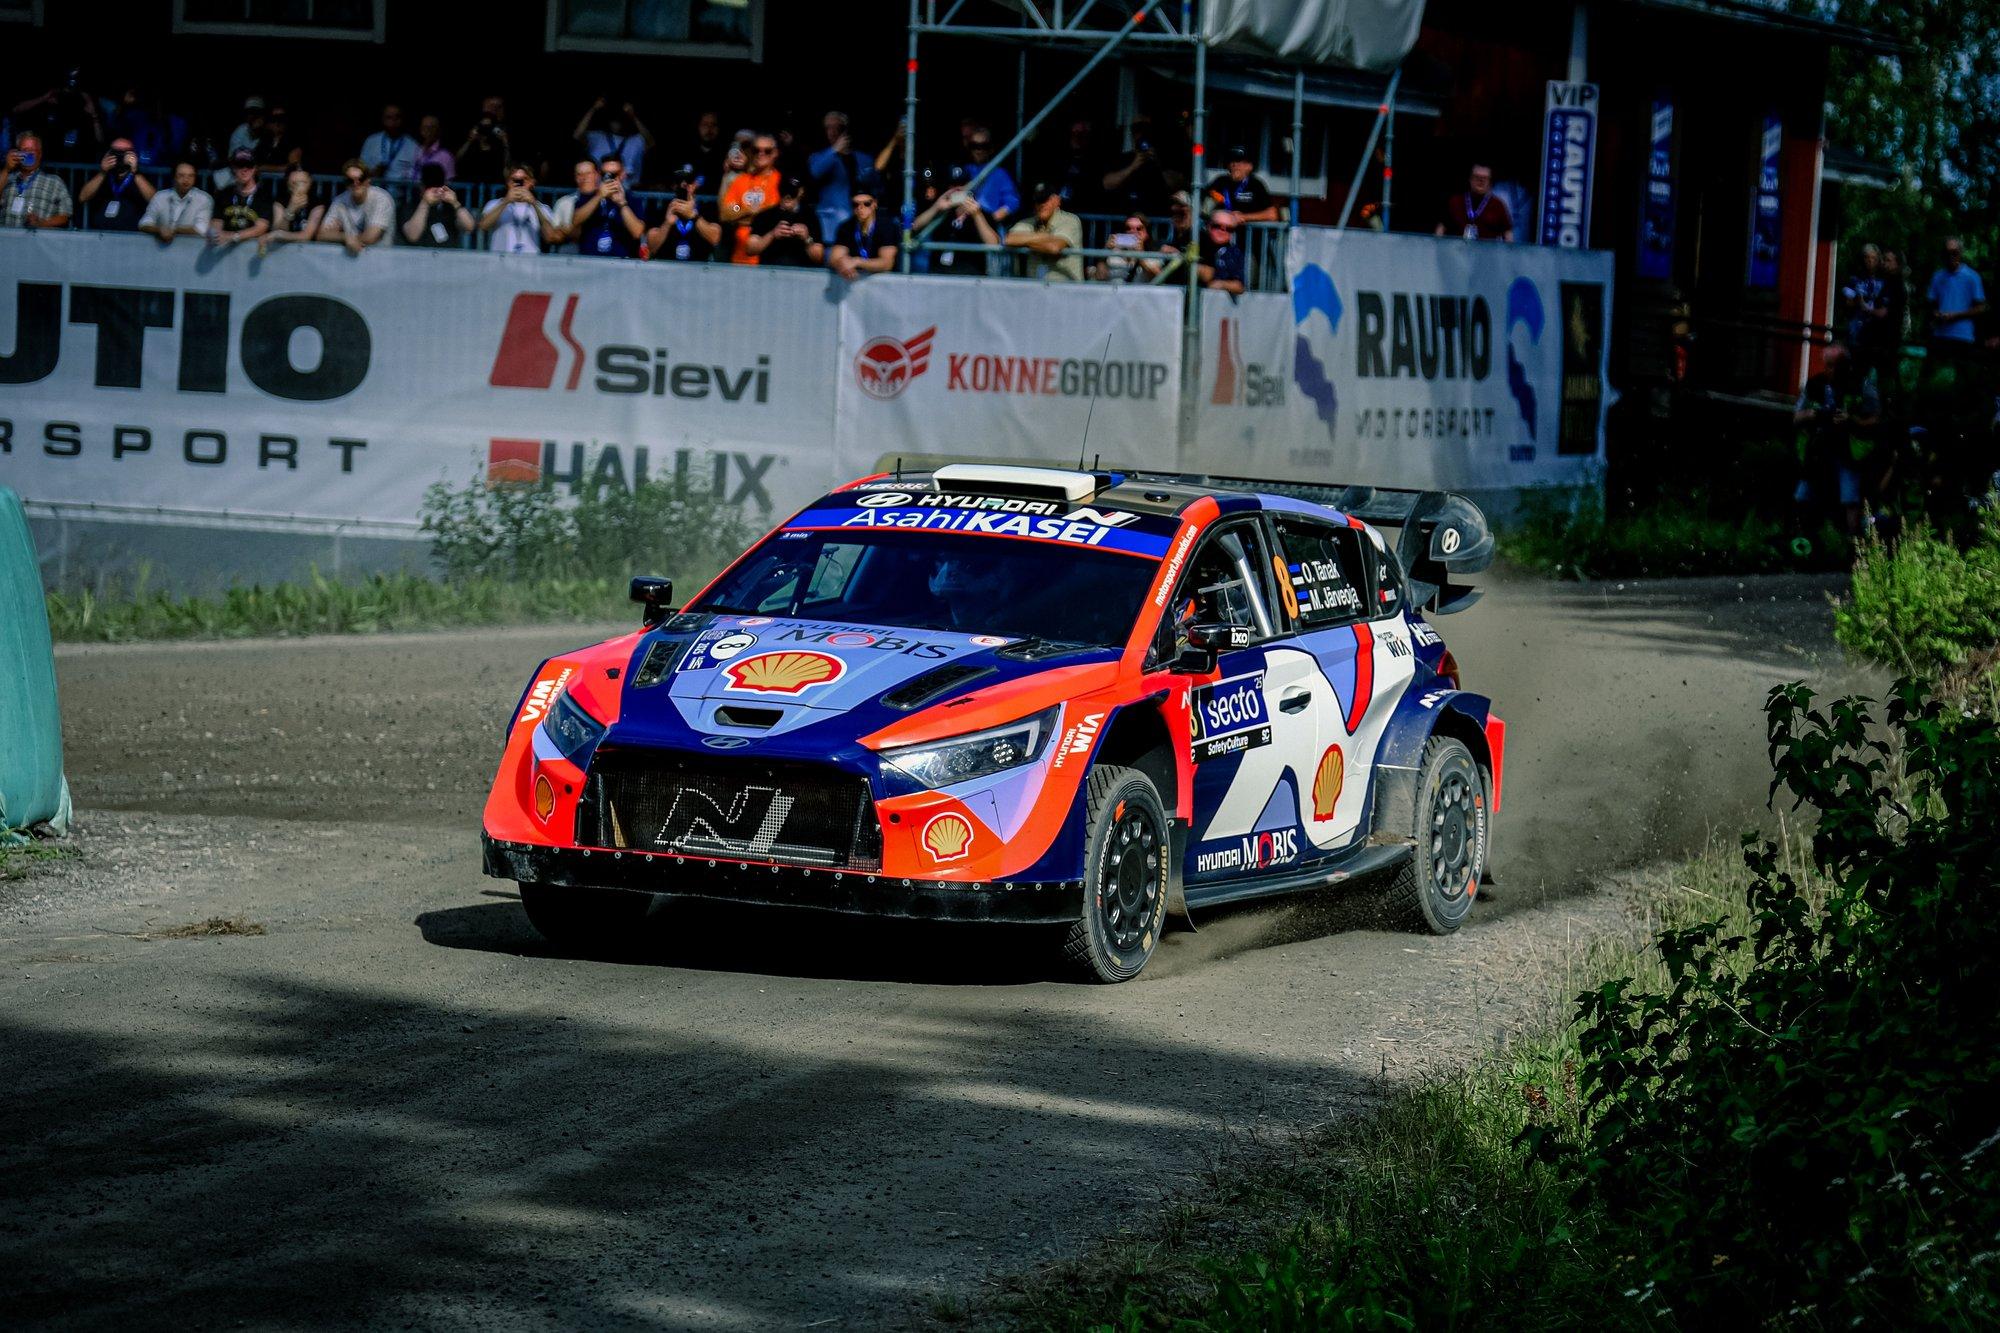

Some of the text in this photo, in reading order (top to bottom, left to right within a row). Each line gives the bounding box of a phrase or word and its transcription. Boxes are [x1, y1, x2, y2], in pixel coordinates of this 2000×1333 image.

[1551, 83, 1598, 106] VIP
[1558, 114, 1589, 248] RAUTIO
[1356, 289, 1492, 382] RAUTIO
[595, 344, 770, 403] Sievi
[947, 353, 1168, 401] KONNEGROUP
[916, 493, 1059, 516] HYUNDAI
[841, 507, 1110, 546] AsahiKASEI
[1154, 524, 1199, 608] motorsport.hyundai.com
[1301, 558, 1341, 584] O. Tänak
[1273, 555, 1299, 619] 8
[1308, 582, 1361, 611] M. Järveoja
[773, 620, 895, 636] HYUNDAI
[773, 626, 959, 659] MOBIS
[1230, 626, 1248, 644] ixo
[520, 678, 557, 723] WIA
[1206, 685, 1260, 733] secto
[1053, 728, 1077, 769] HYUNDAI
[1069, 712, 1105, 754] WIA
[1206, 734, 1249, 757] SafetyCulture
[1197, 828, 1298, 873] HYUNDAI MOBIS
